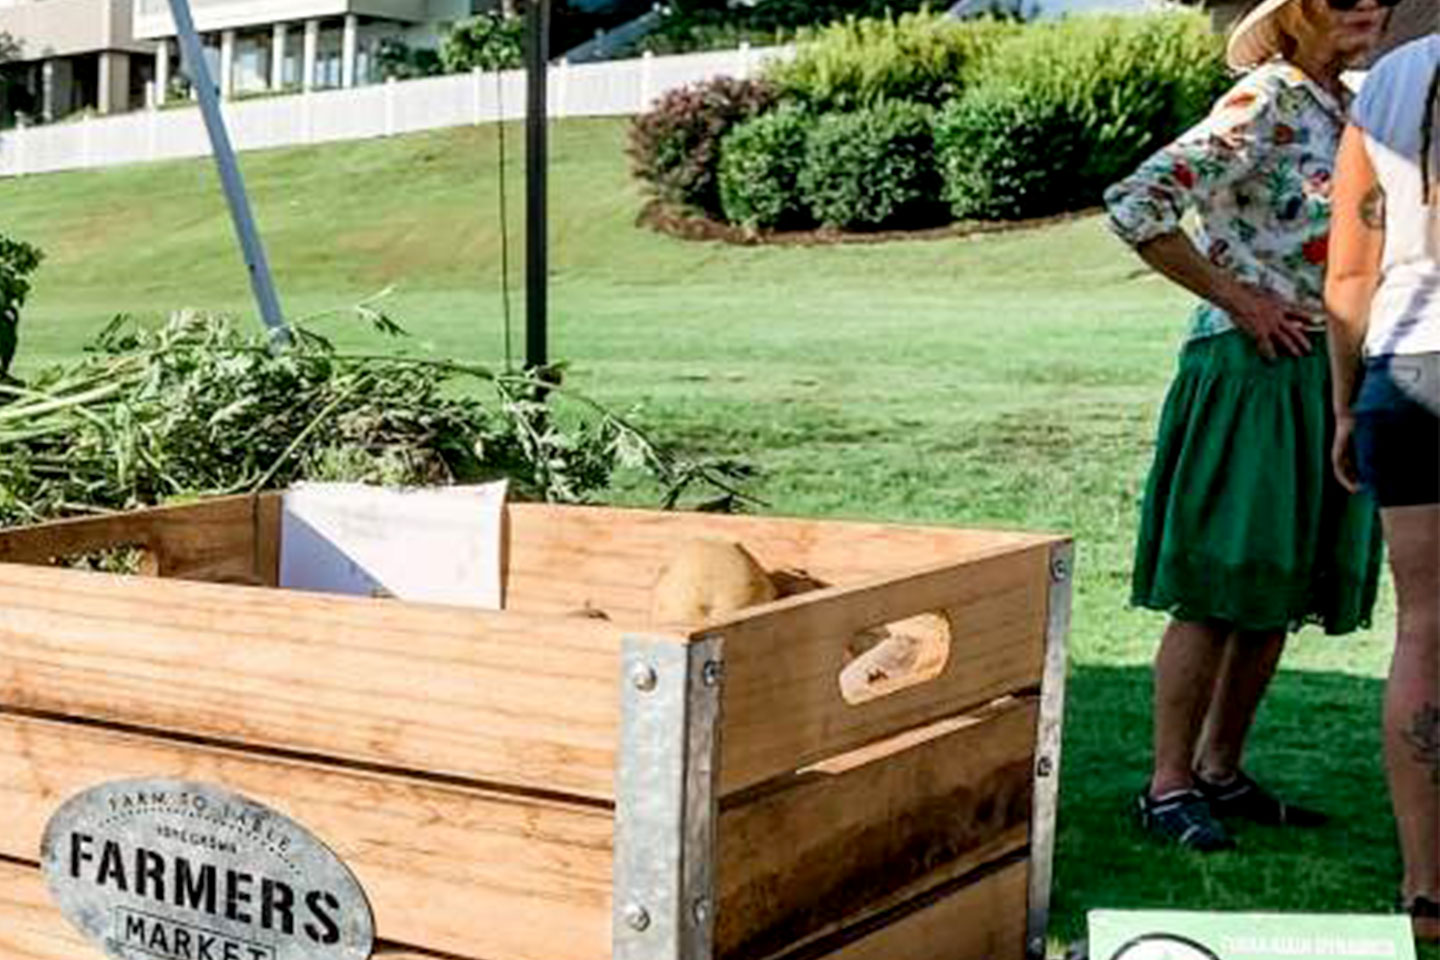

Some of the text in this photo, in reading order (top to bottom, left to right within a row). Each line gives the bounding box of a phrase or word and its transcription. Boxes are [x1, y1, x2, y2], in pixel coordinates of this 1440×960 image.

[109, 791, 292, 853] FARM TO TABLE
[69, 831, 342, 945] FARMERS
